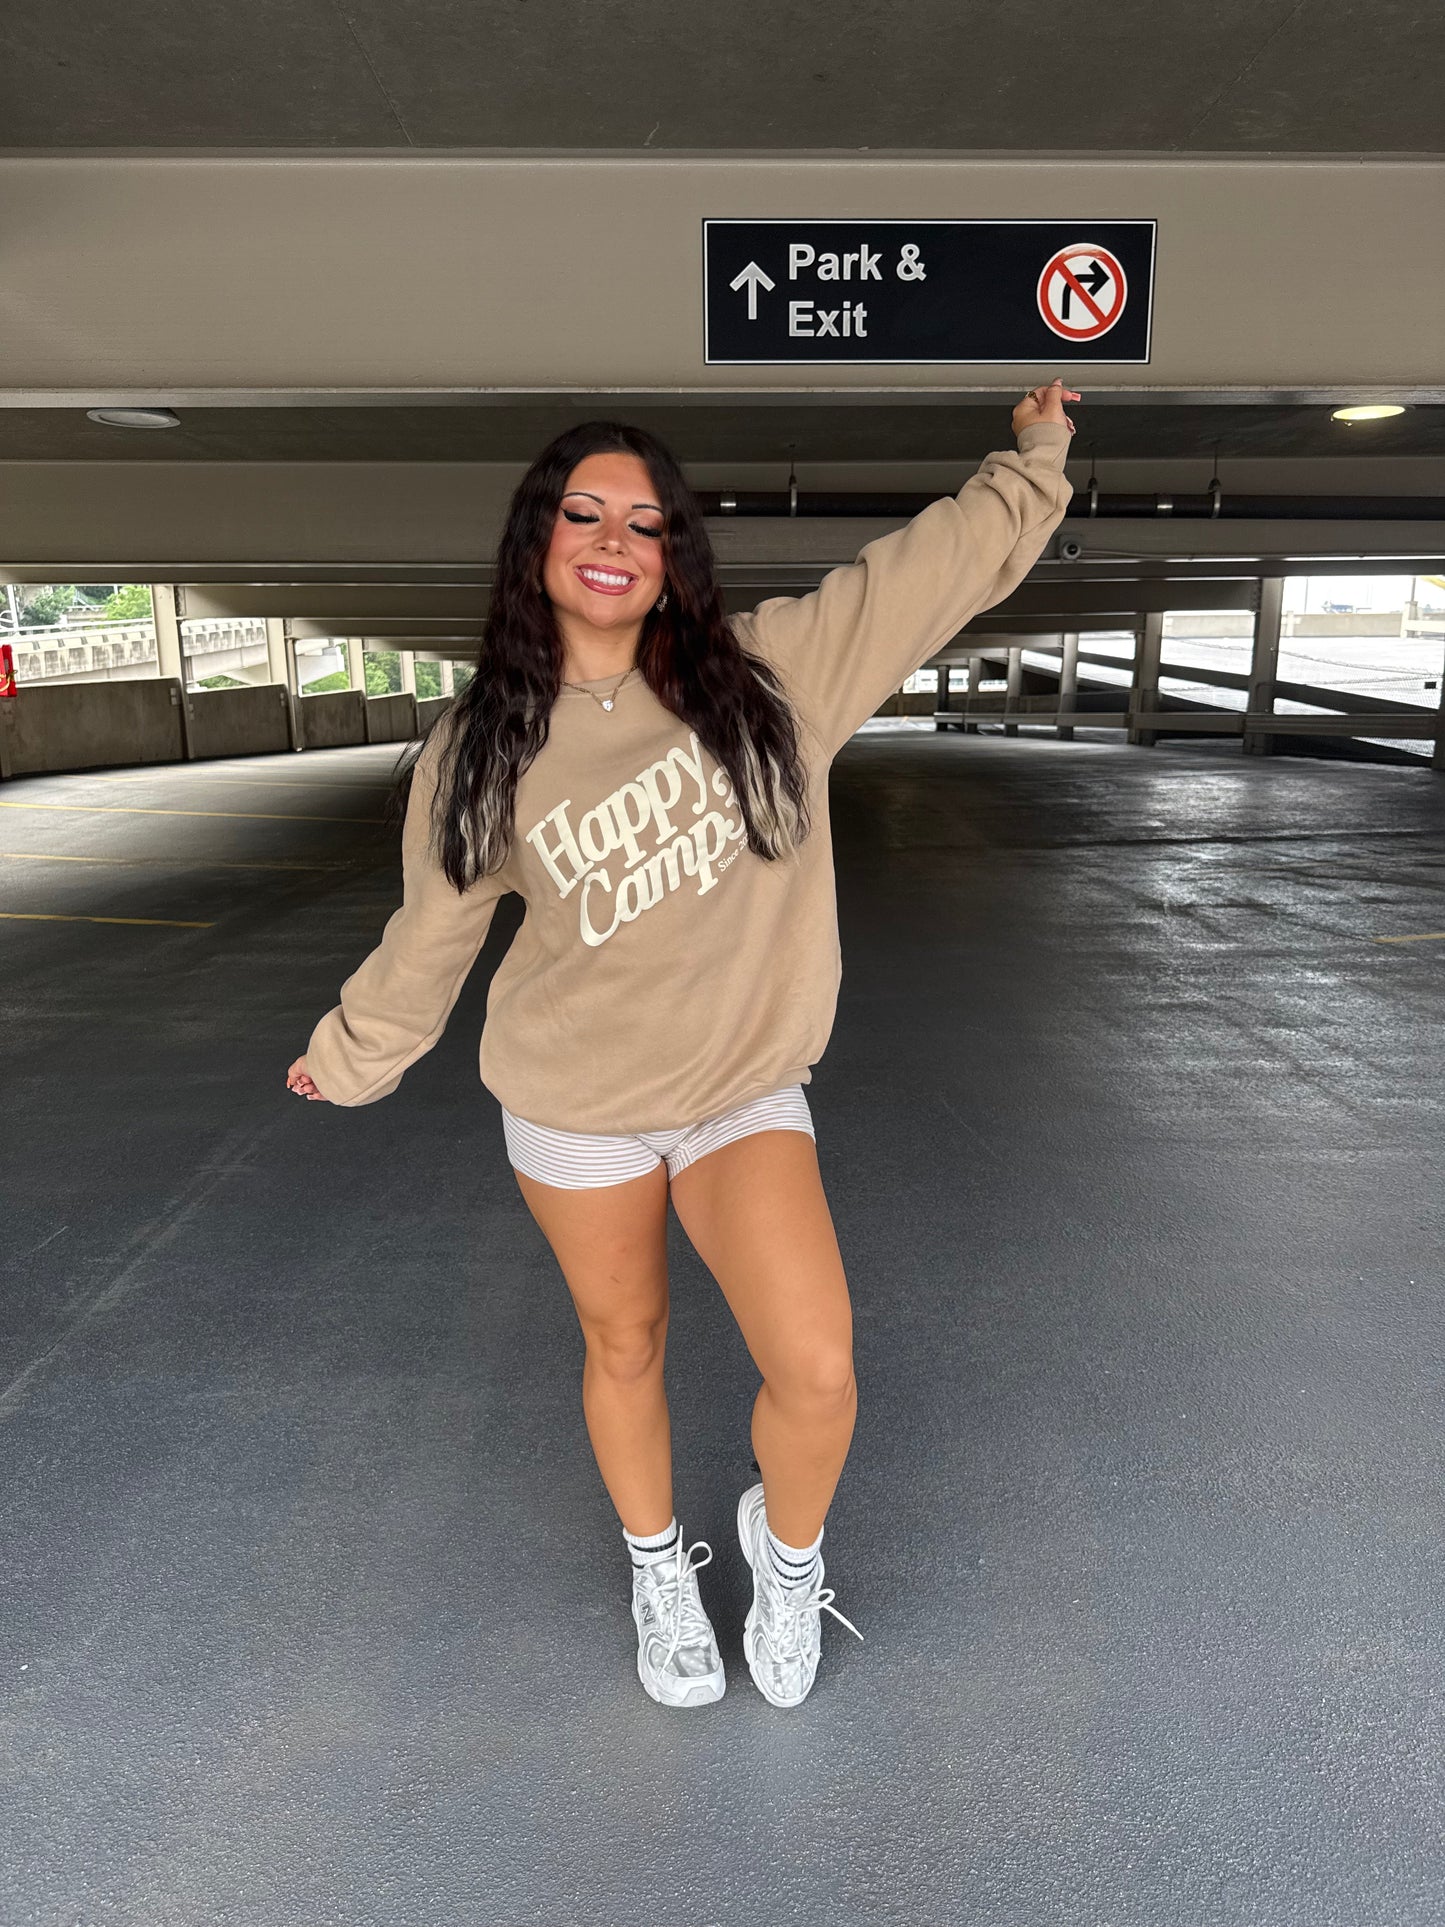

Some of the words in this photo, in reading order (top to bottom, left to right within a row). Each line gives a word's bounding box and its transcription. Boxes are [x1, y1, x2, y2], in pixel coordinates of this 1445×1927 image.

[788, 243, 883, 281] Park
[896, 243, 927, 281] &
[788, 300, 868, 338] Exit
[525, 731, 708, 900] Happy
[717, 848, 739, 873] Since
